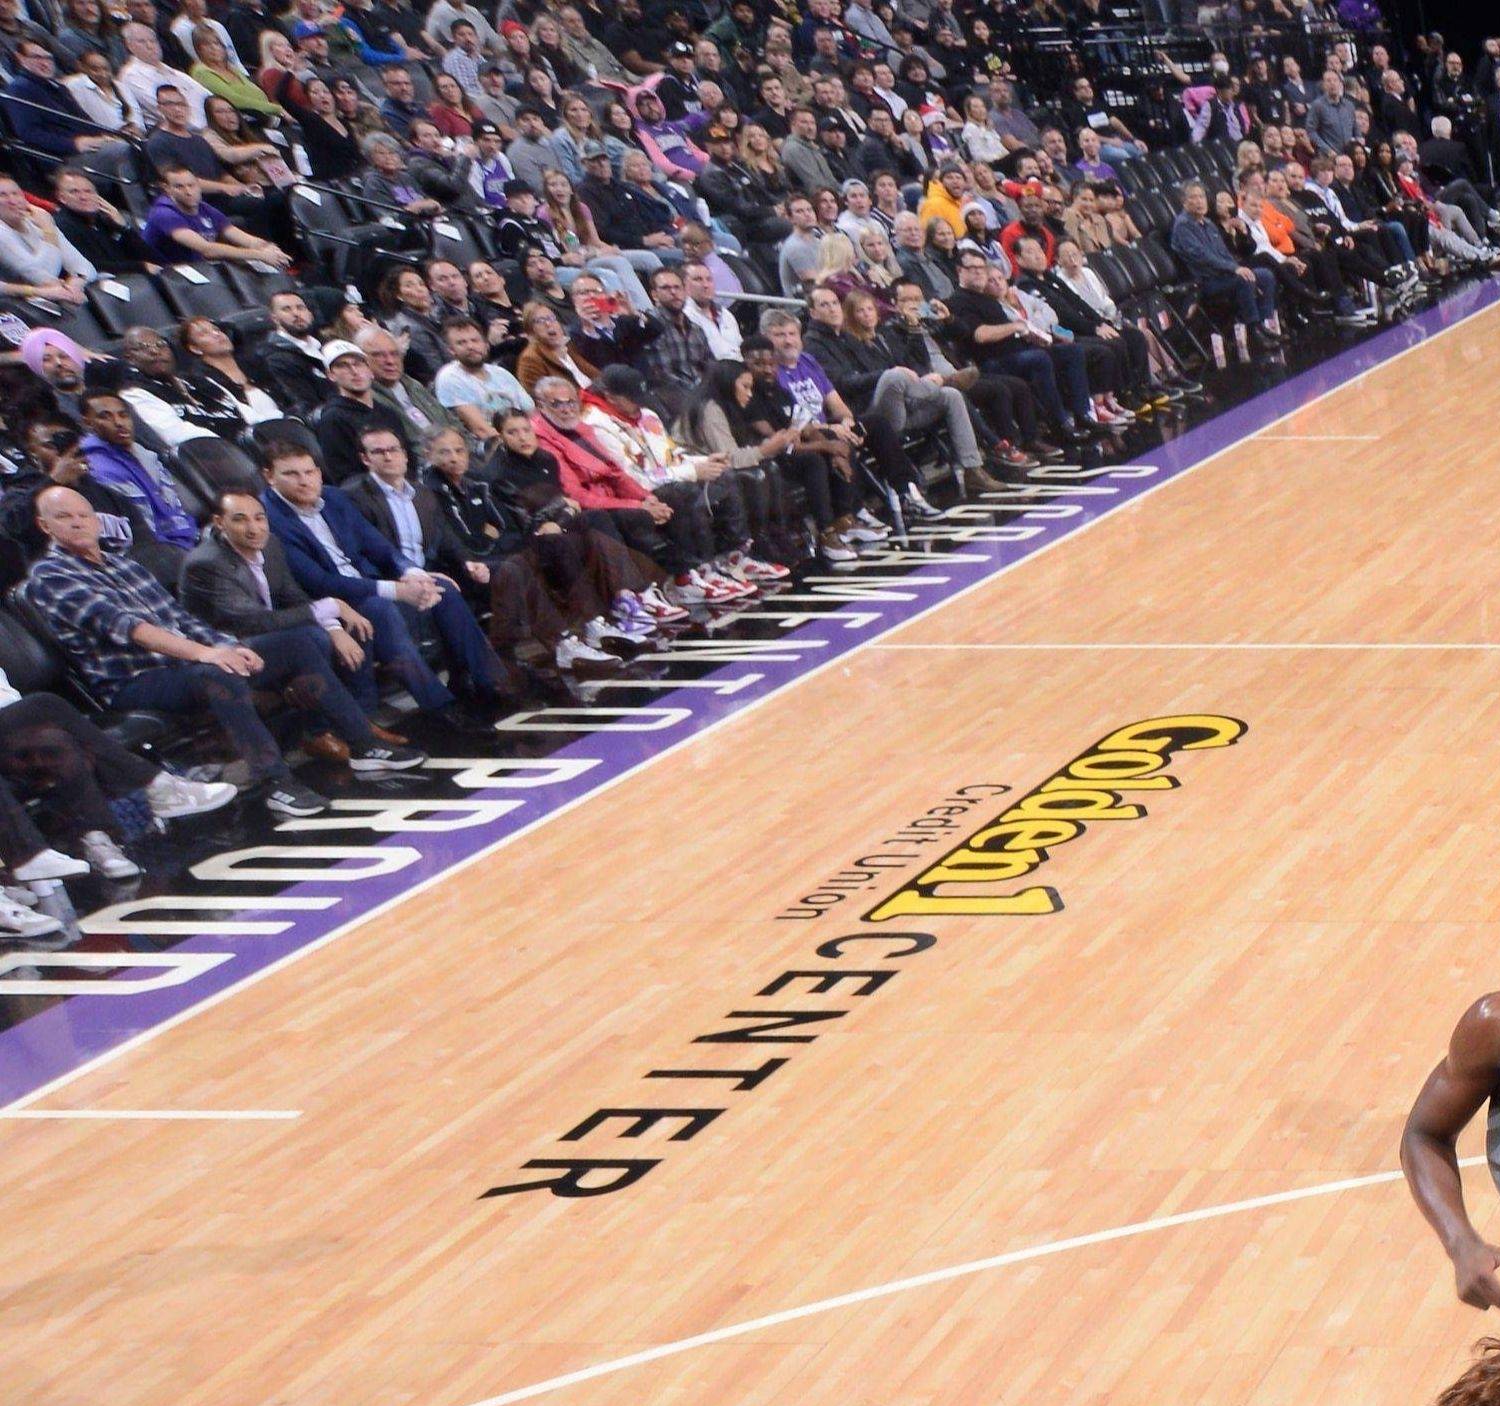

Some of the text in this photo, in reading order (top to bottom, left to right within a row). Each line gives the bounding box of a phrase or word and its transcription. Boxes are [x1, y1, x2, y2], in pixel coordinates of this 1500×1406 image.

[0, 464, 1159, 995] SACRAMENTO PROUD
[776, 783, 1012, 920] Credit Union
[479, 932, 938, 1200] CENTER
